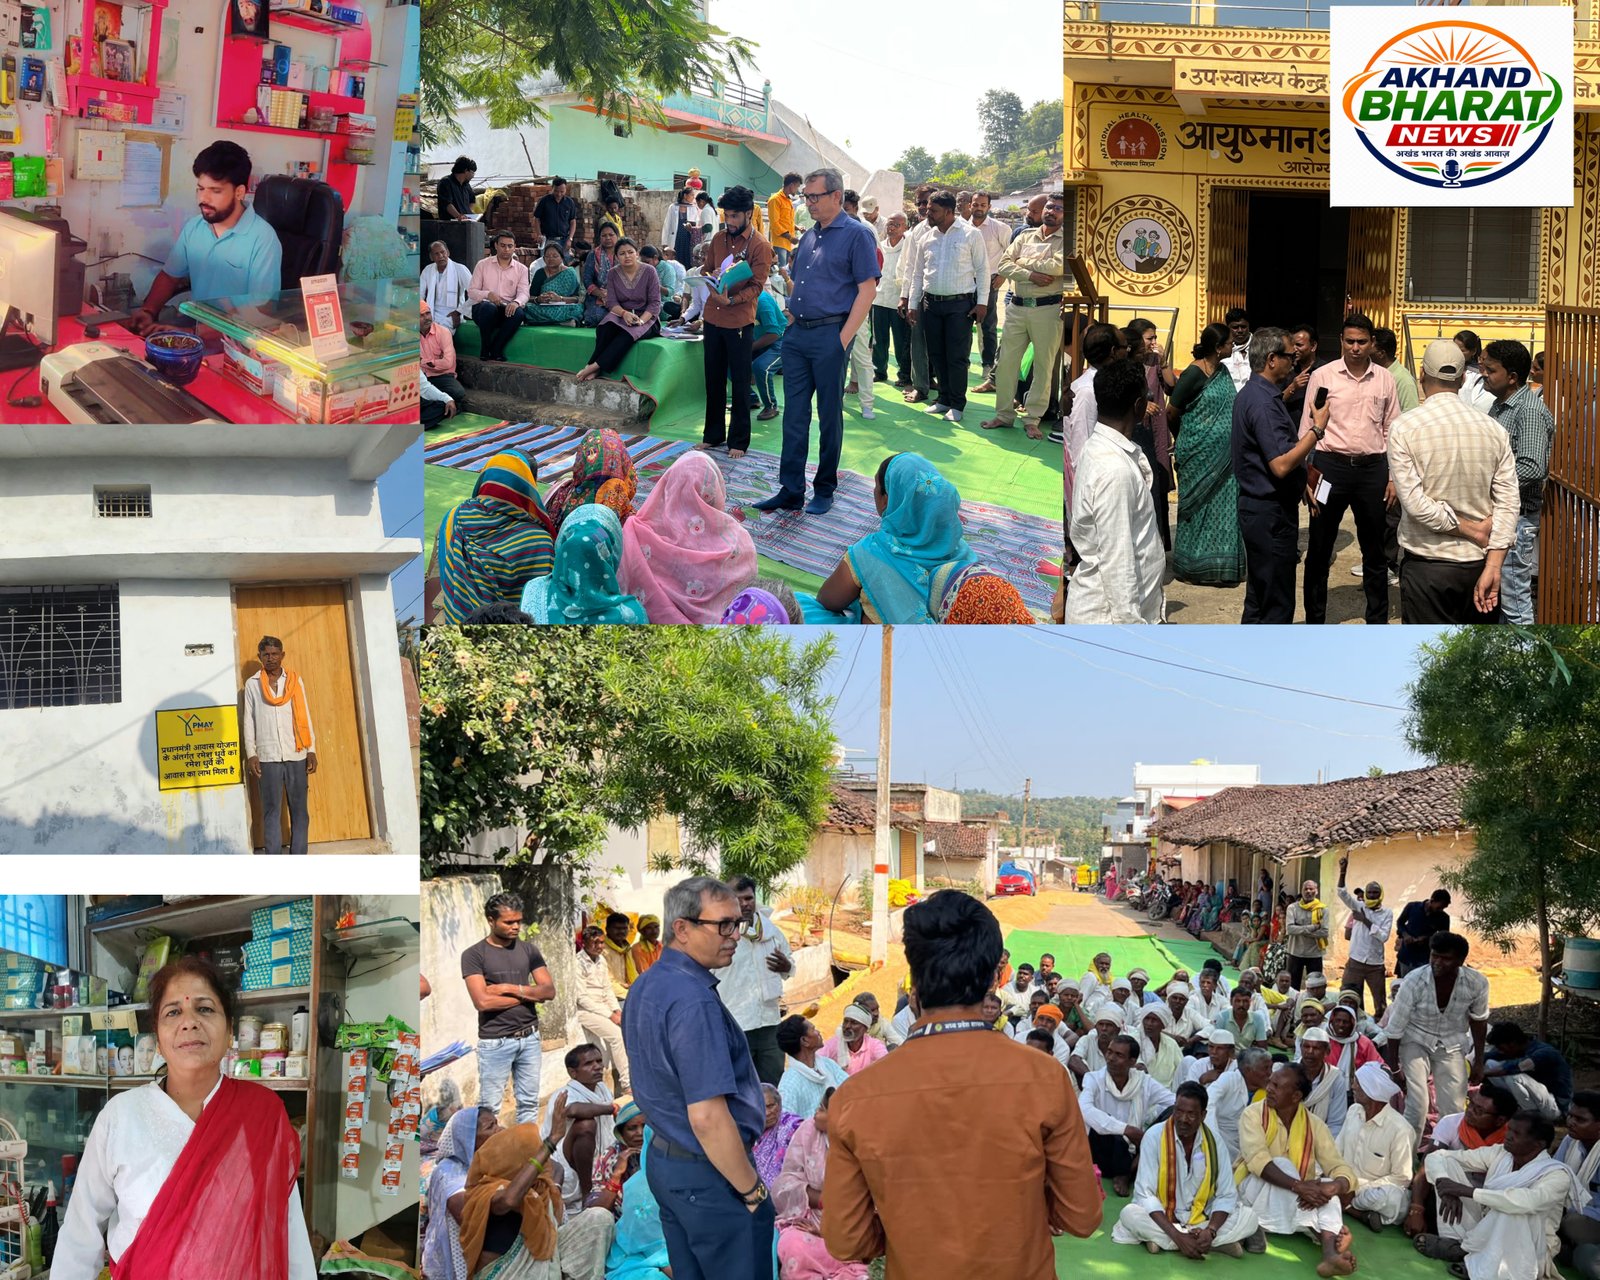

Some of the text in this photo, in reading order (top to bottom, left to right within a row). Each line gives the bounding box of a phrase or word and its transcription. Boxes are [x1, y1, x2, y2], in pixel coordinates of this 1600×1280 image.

[1287, 65, 1329, 94] केन्द्र
[1100, 111, 1168, 160] NATIONAL HEALTH MISSION
[1174, 121, 1317, 164] आयुष्मान
[161, 744, 191, 754] प्रधानमंत्री
[216, 741, 237, 749] योजना
[172, 753, 194, 761] अंतर्गत
[185, 759, 200, 768] रमेश
[164, 772, 185, 780] आवास
[187, 770, 196, 778] का
[213, 766, 228, 775] मिला
[229, 765, 235, 774] है
